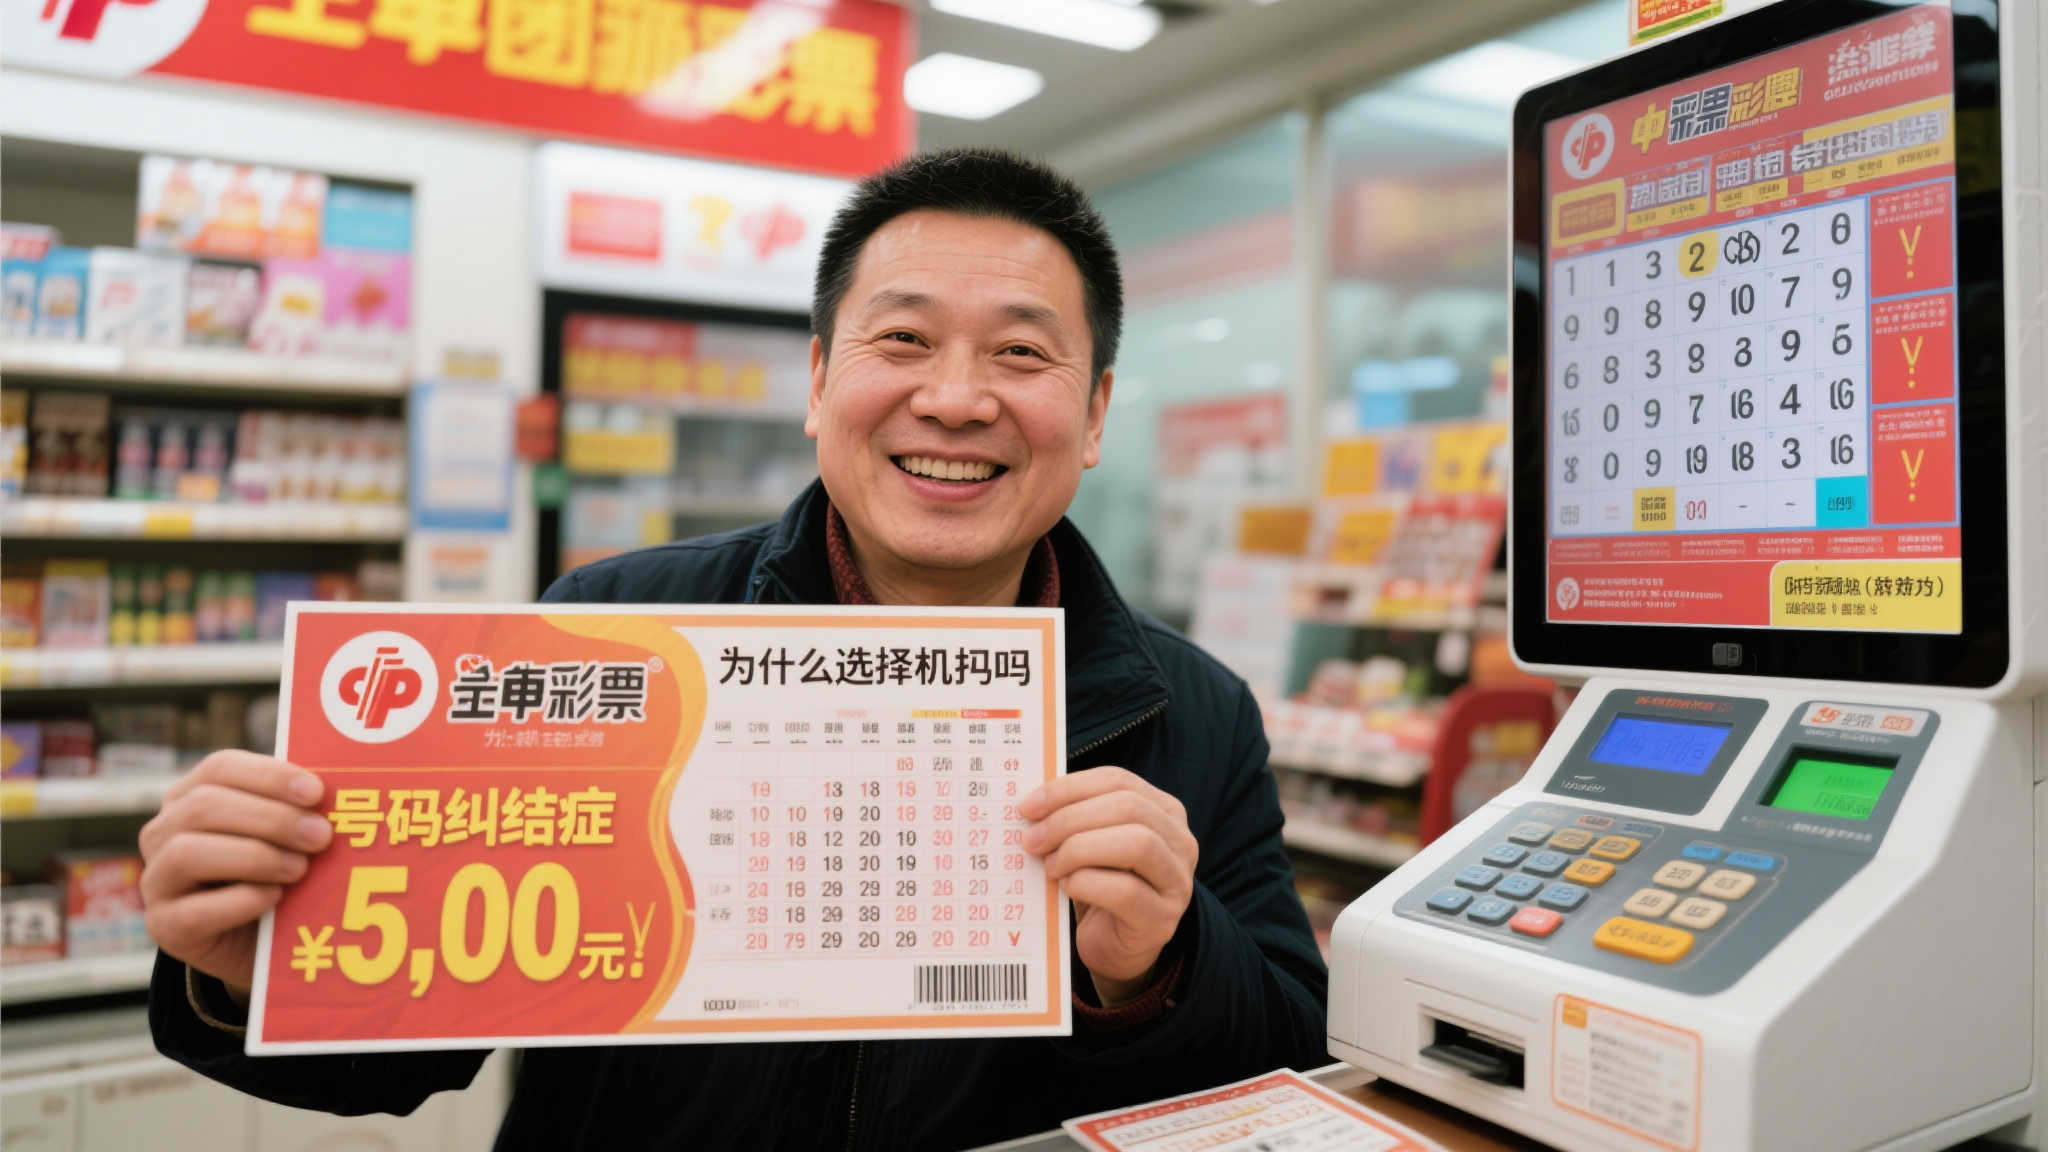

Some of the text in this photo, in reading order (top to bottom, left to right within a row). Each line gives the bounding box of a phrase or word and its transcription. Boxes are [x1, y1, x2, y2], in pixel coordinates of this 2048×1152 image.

[1566, 265, 1575, 297] 1
[1605, 259, 1616, 287] 1
[1646, 250, 1662, 279] 3
[1689, 242, 1705, 273] 2
[1781, 222, 1800, 255] 2
[1563, 314, 1580, 342] 9
[1645, 299, 1662, 329] 8
[1688, 291, 1706, 323] 9
[1731, 284, 1754, 316] 10
[1781, 276, 1801, 308] 7
[1832, 267, 1852, 300] 9
[1563, 362, 1579, 390] 6
[1603, 355, 1619, 384] 8
[1645, 349, 1662, 379] 3
[1781, 329, 1800, 361] 9
[1603, 403, 1620, 433] 0
[1644, 398, 1661, 428] 9
[1688, 394, 1704, 424] 7
[1731, 388, 1754, 419] 16
[1779, 383, 1801, 415] 4
[1603, 452, 1620, 480] 0
[1645, 448, 1662, 477] 9
[1731, 441, 1754, 472] 18
[1781, 437, 1801, 469] 3
[1830, 433, 1854, 465] 16
[824, 781, 843, 798] 13
[861, 781, 880, 798] 18
[328, 786, 617, 848] 号码纠结症
[750, 806, 770, 822] 10
[786, 806, 807, 822] 10
[860, 806, 881, 821] 20
[788, 831, 807, 847] 18
[824, 831, 843, 847] 12
[859, 830, 881, 847] 20
[858, 931, 880, 947] 20
